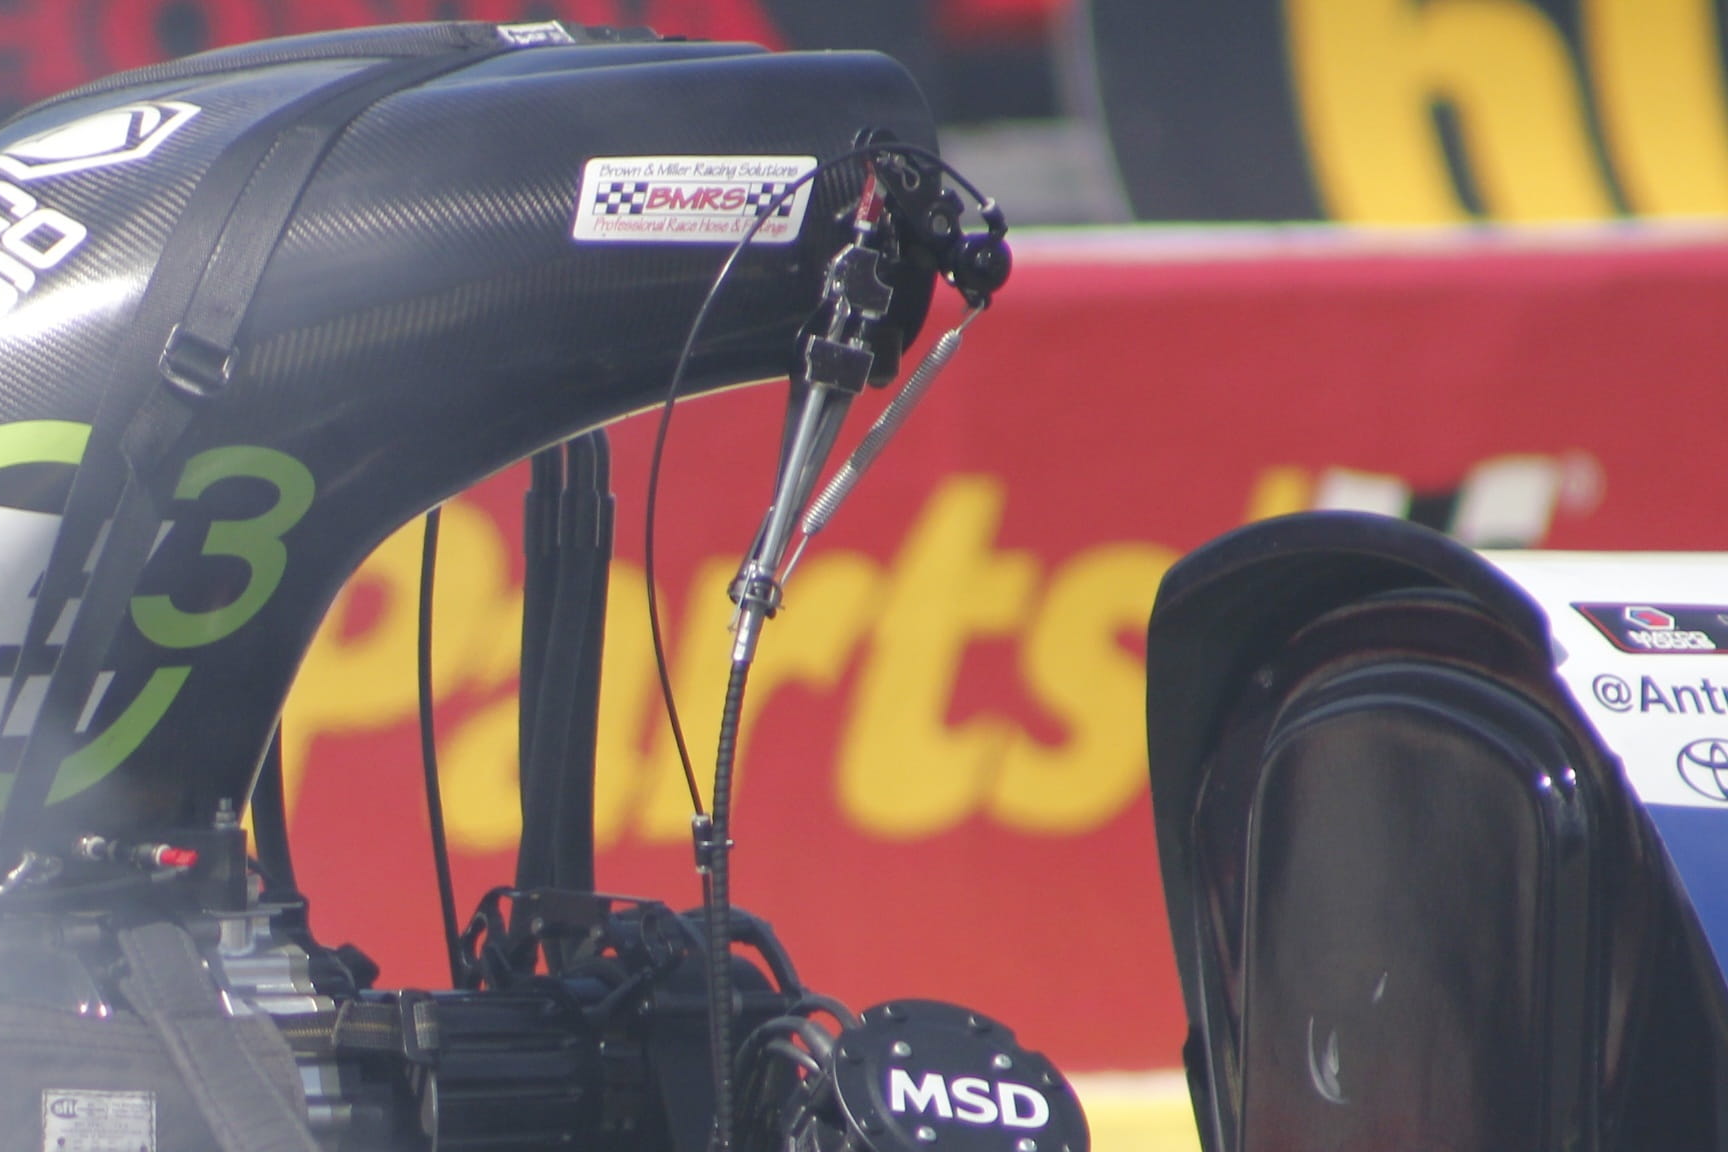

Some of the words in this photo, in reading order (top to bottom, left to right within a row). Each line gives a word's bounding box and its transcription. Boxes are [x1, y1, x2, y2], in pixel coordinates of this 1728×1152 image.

[599, 163, 640, 177] Brown
[657, 162, 690, 176] Miller
[693, 162, 735, 180] Racing
[737, 161, 798, 177] Solutions
[645, 186, 746, 211] BMRS
[593, 217, 665, 233] Professional
[667, 217, 698, 233] Race
[1591, 672, 1728, 714] @Ant
[890, 1068, 1050, 1129] MSD
